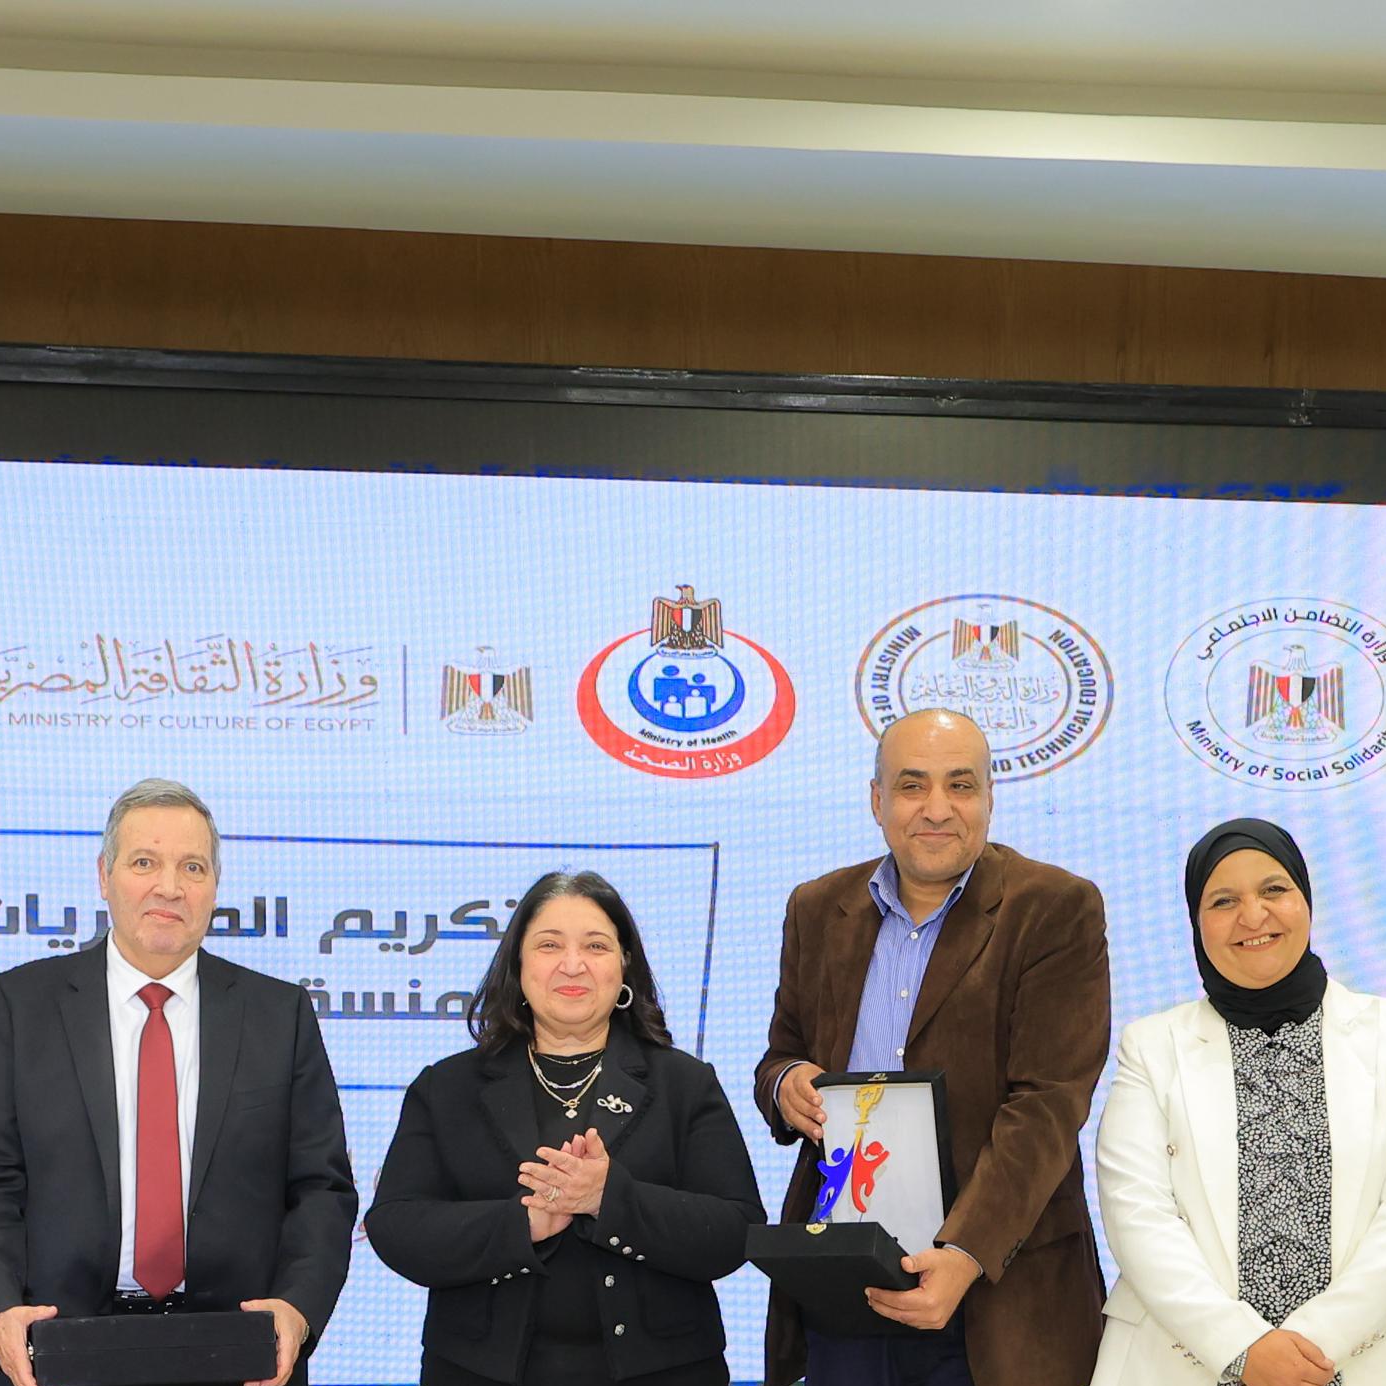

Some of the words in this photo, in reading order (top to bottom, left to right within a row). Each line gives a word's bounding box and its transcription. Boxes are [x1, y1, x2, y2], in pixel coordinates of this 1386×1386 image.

[1197, 607, 1279, 661] الاجتماعي
[1285, 607, 1363, 635] التضامن
[253, 641, 377, 707] وزارة
[870, 625, 923, 691] MINISTRY
[1048, 629, 1097, 706] EDUCATION
[9, 712, 113, 728] MINISTRY
[121, 713, 152, 729] OF
[159, 714, 258, 730] CULTURE
[265, 716, 299, 731] OF
[305, 717, 375, 732] EGYPT
[872, 695, 893, 711] OF
[623, 744, 696, 771] الصحة
[638, 728, 683, 748] Ministry
[687, 739, 699, 747] of
[702, 729, 738, 745] Health
[1015, 709, 1093, 768] TECHNICAL
[1186, 720, 1244, 772] Ministry
[1248, 764, 1269, 777] of
[1272, 765, 1329, 782] Social
[701, 752, 742, 772] وزارة
[991, 758, 1012, 773] ND
[319, 899, 517, 955] كريم
